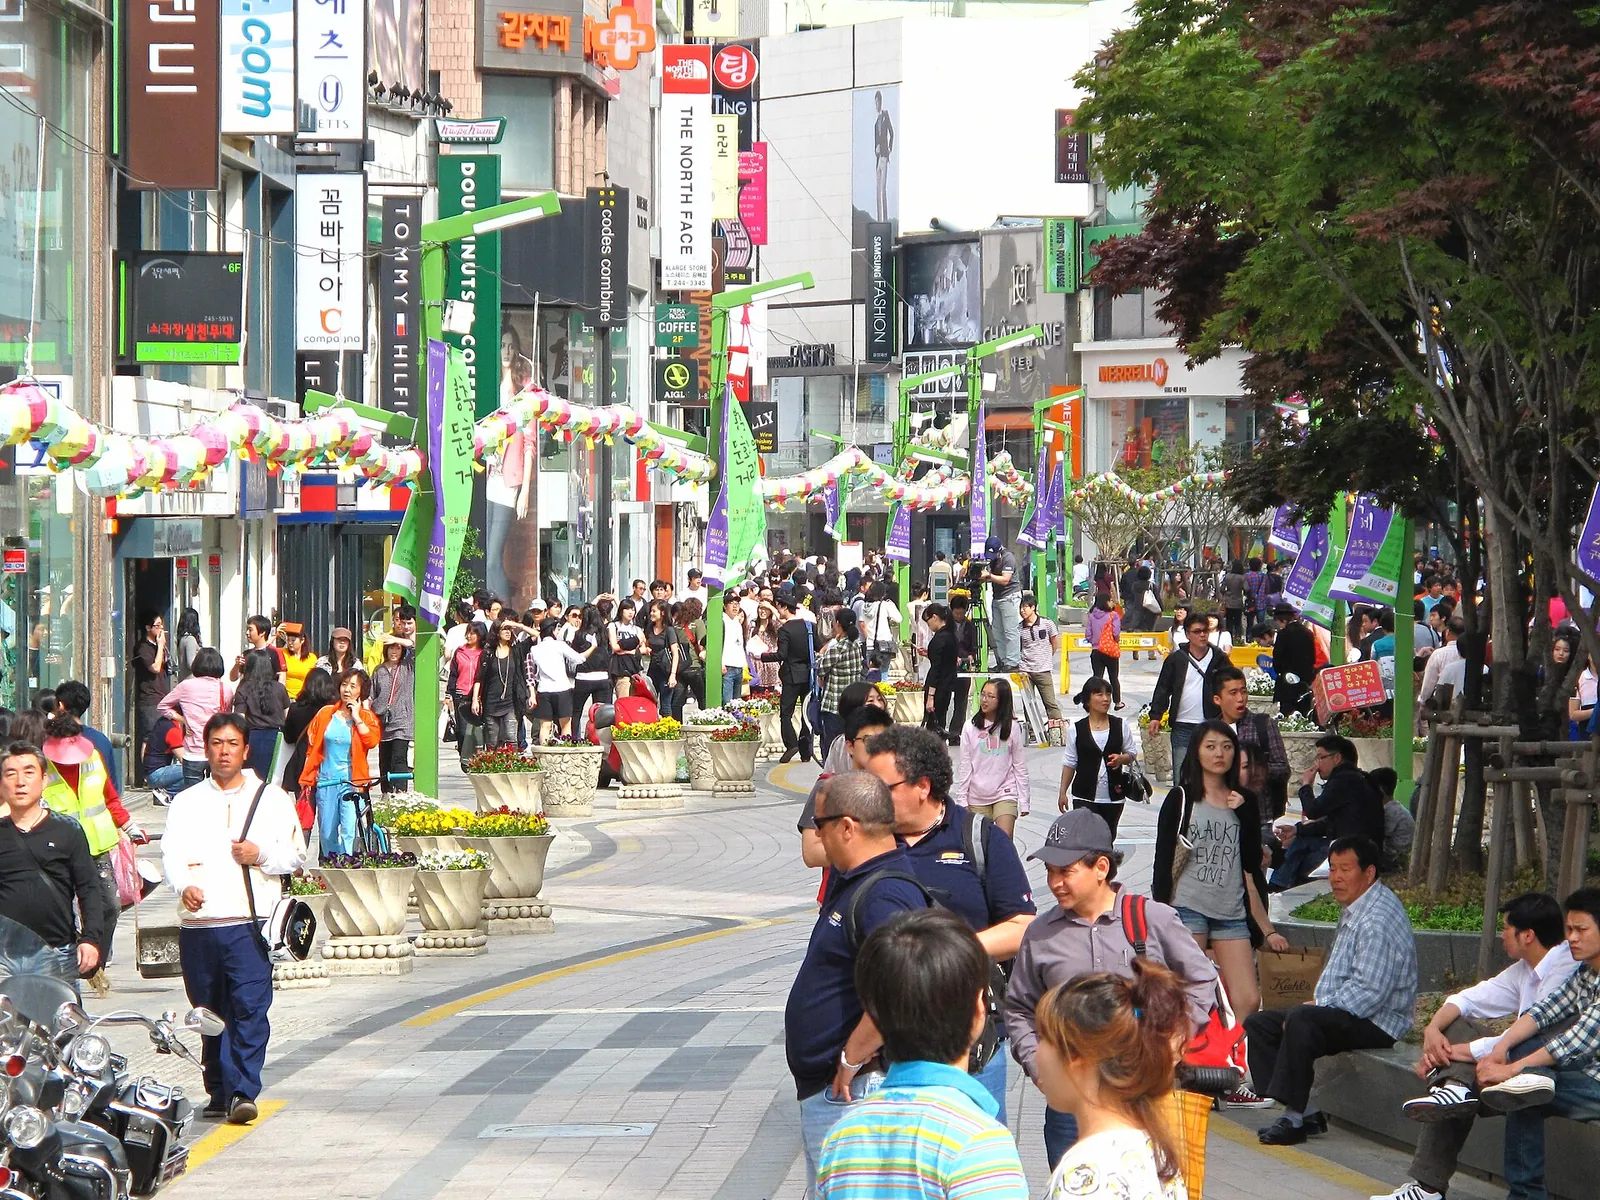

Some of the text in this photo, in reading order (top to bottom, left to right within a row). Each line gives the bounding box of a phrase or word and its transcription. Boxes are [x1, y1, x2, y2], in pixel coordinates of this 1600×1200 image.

[665, 65, 694, 73] NORTH
[680, 106, 693, 255] THE NORTH FACE
[461, 162, 476, 301] DOUNUTS
[393, 205, 410, 304] TOMMY
[600, 209, 615, 322] codes combine
[873, 236, 882, 278] SAMSUNG
[874, 280, 886, 343] FASHION
[658, 322, 697, 333] COFFEE
[672, 335, 684, 343] 2F
[789, 343, 836, 368] FASHION
[1099, 363, 1154, 383] MERRELL
[428, 544, 445, 556] 201
[1195, 844, 1240, 869] EVERY
[1197, 865, 1227, 888] ONE
[1269, 976, 1311, 996] Kiehl's
